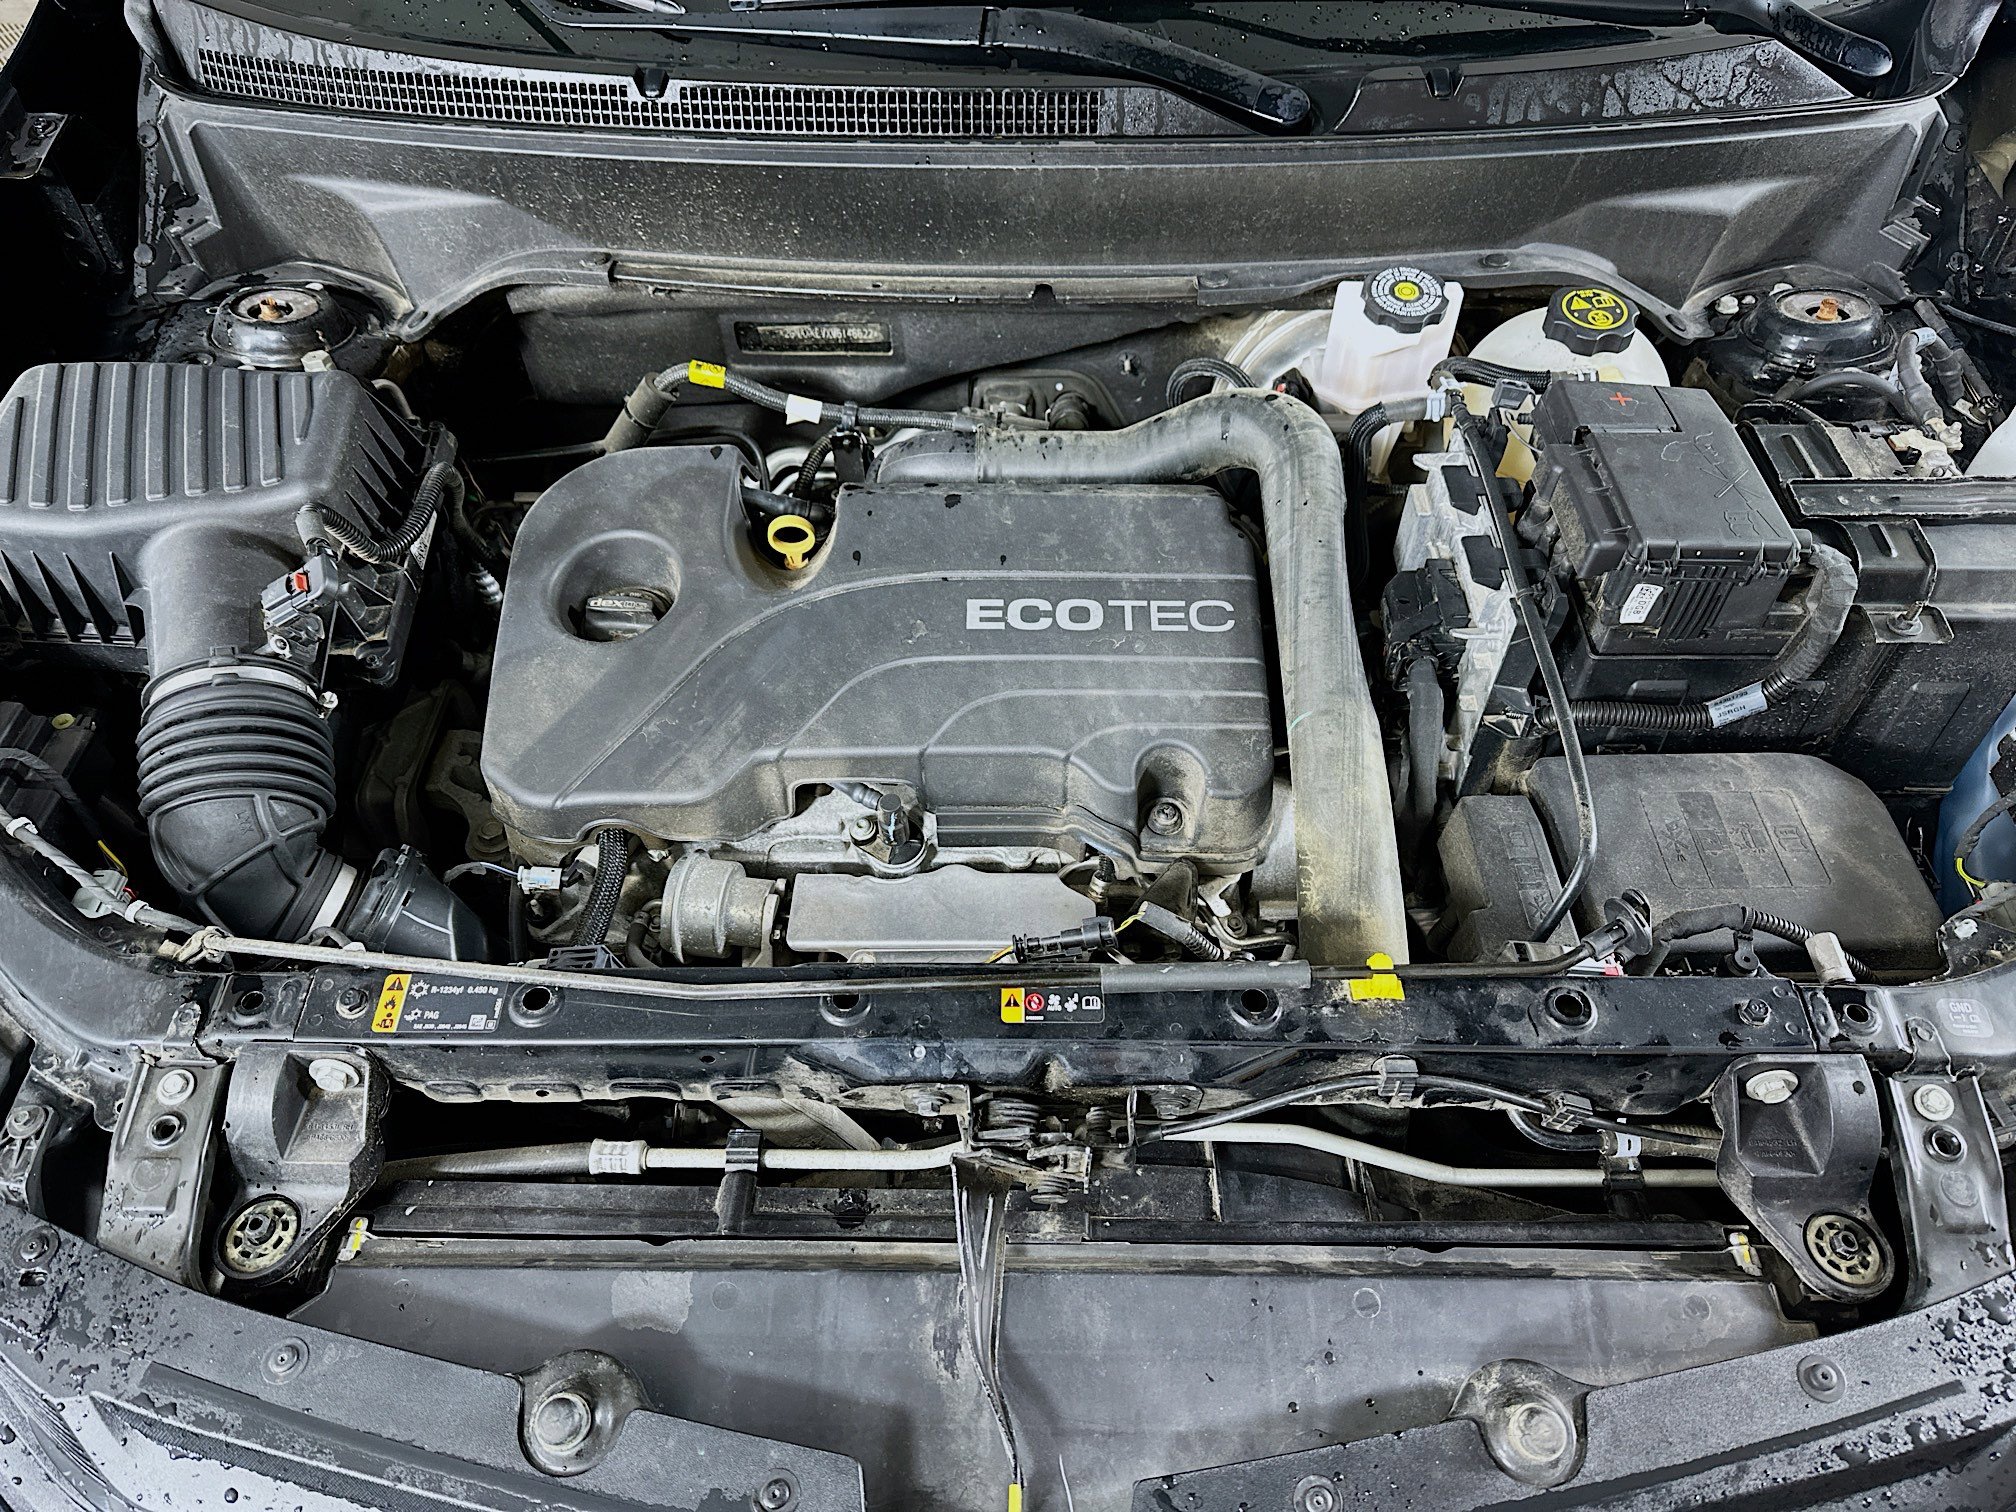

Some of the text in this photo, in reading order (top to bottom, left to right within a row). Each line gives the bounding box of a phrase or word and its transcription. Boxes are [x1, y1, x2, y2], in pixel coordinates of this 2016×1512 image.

[589, 598, 648, 609] dexos
[966, 598, 1236, 633] ECOTEC
[467, 985, 488, 994] 0.450
[488, 985, 499, 995] kg
[1949, 1002, 1972, 1012] GND
[423, 1011, 440, 1020] PAG
